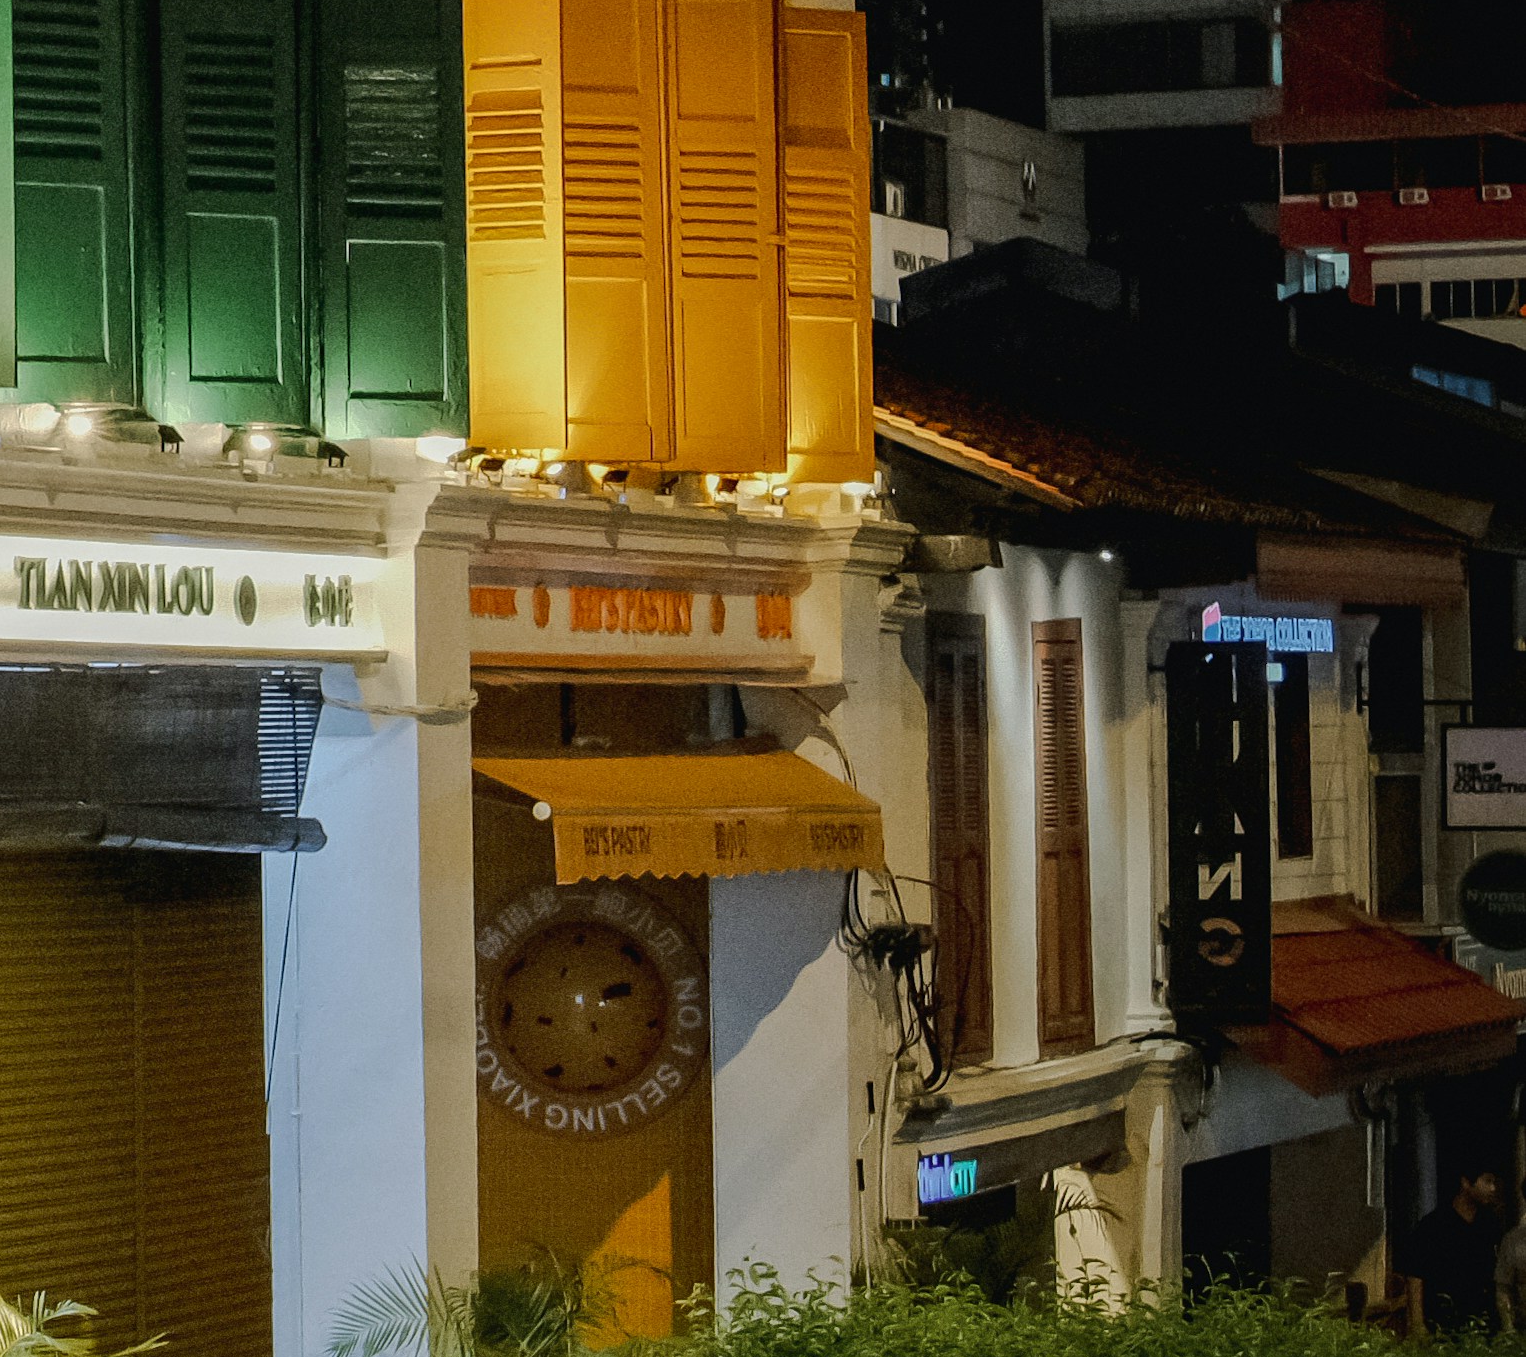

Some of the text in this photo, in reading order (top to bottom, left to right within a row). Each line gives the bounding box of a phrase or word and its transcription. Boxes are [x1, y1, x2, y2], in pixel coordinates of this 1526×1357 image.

[15, 556, 93, 613] TIAN
[96, 561, 150, 615] XIN
[156, 563, 215, 617] LOU
[545, 1063, 683, 1132] SELLING
